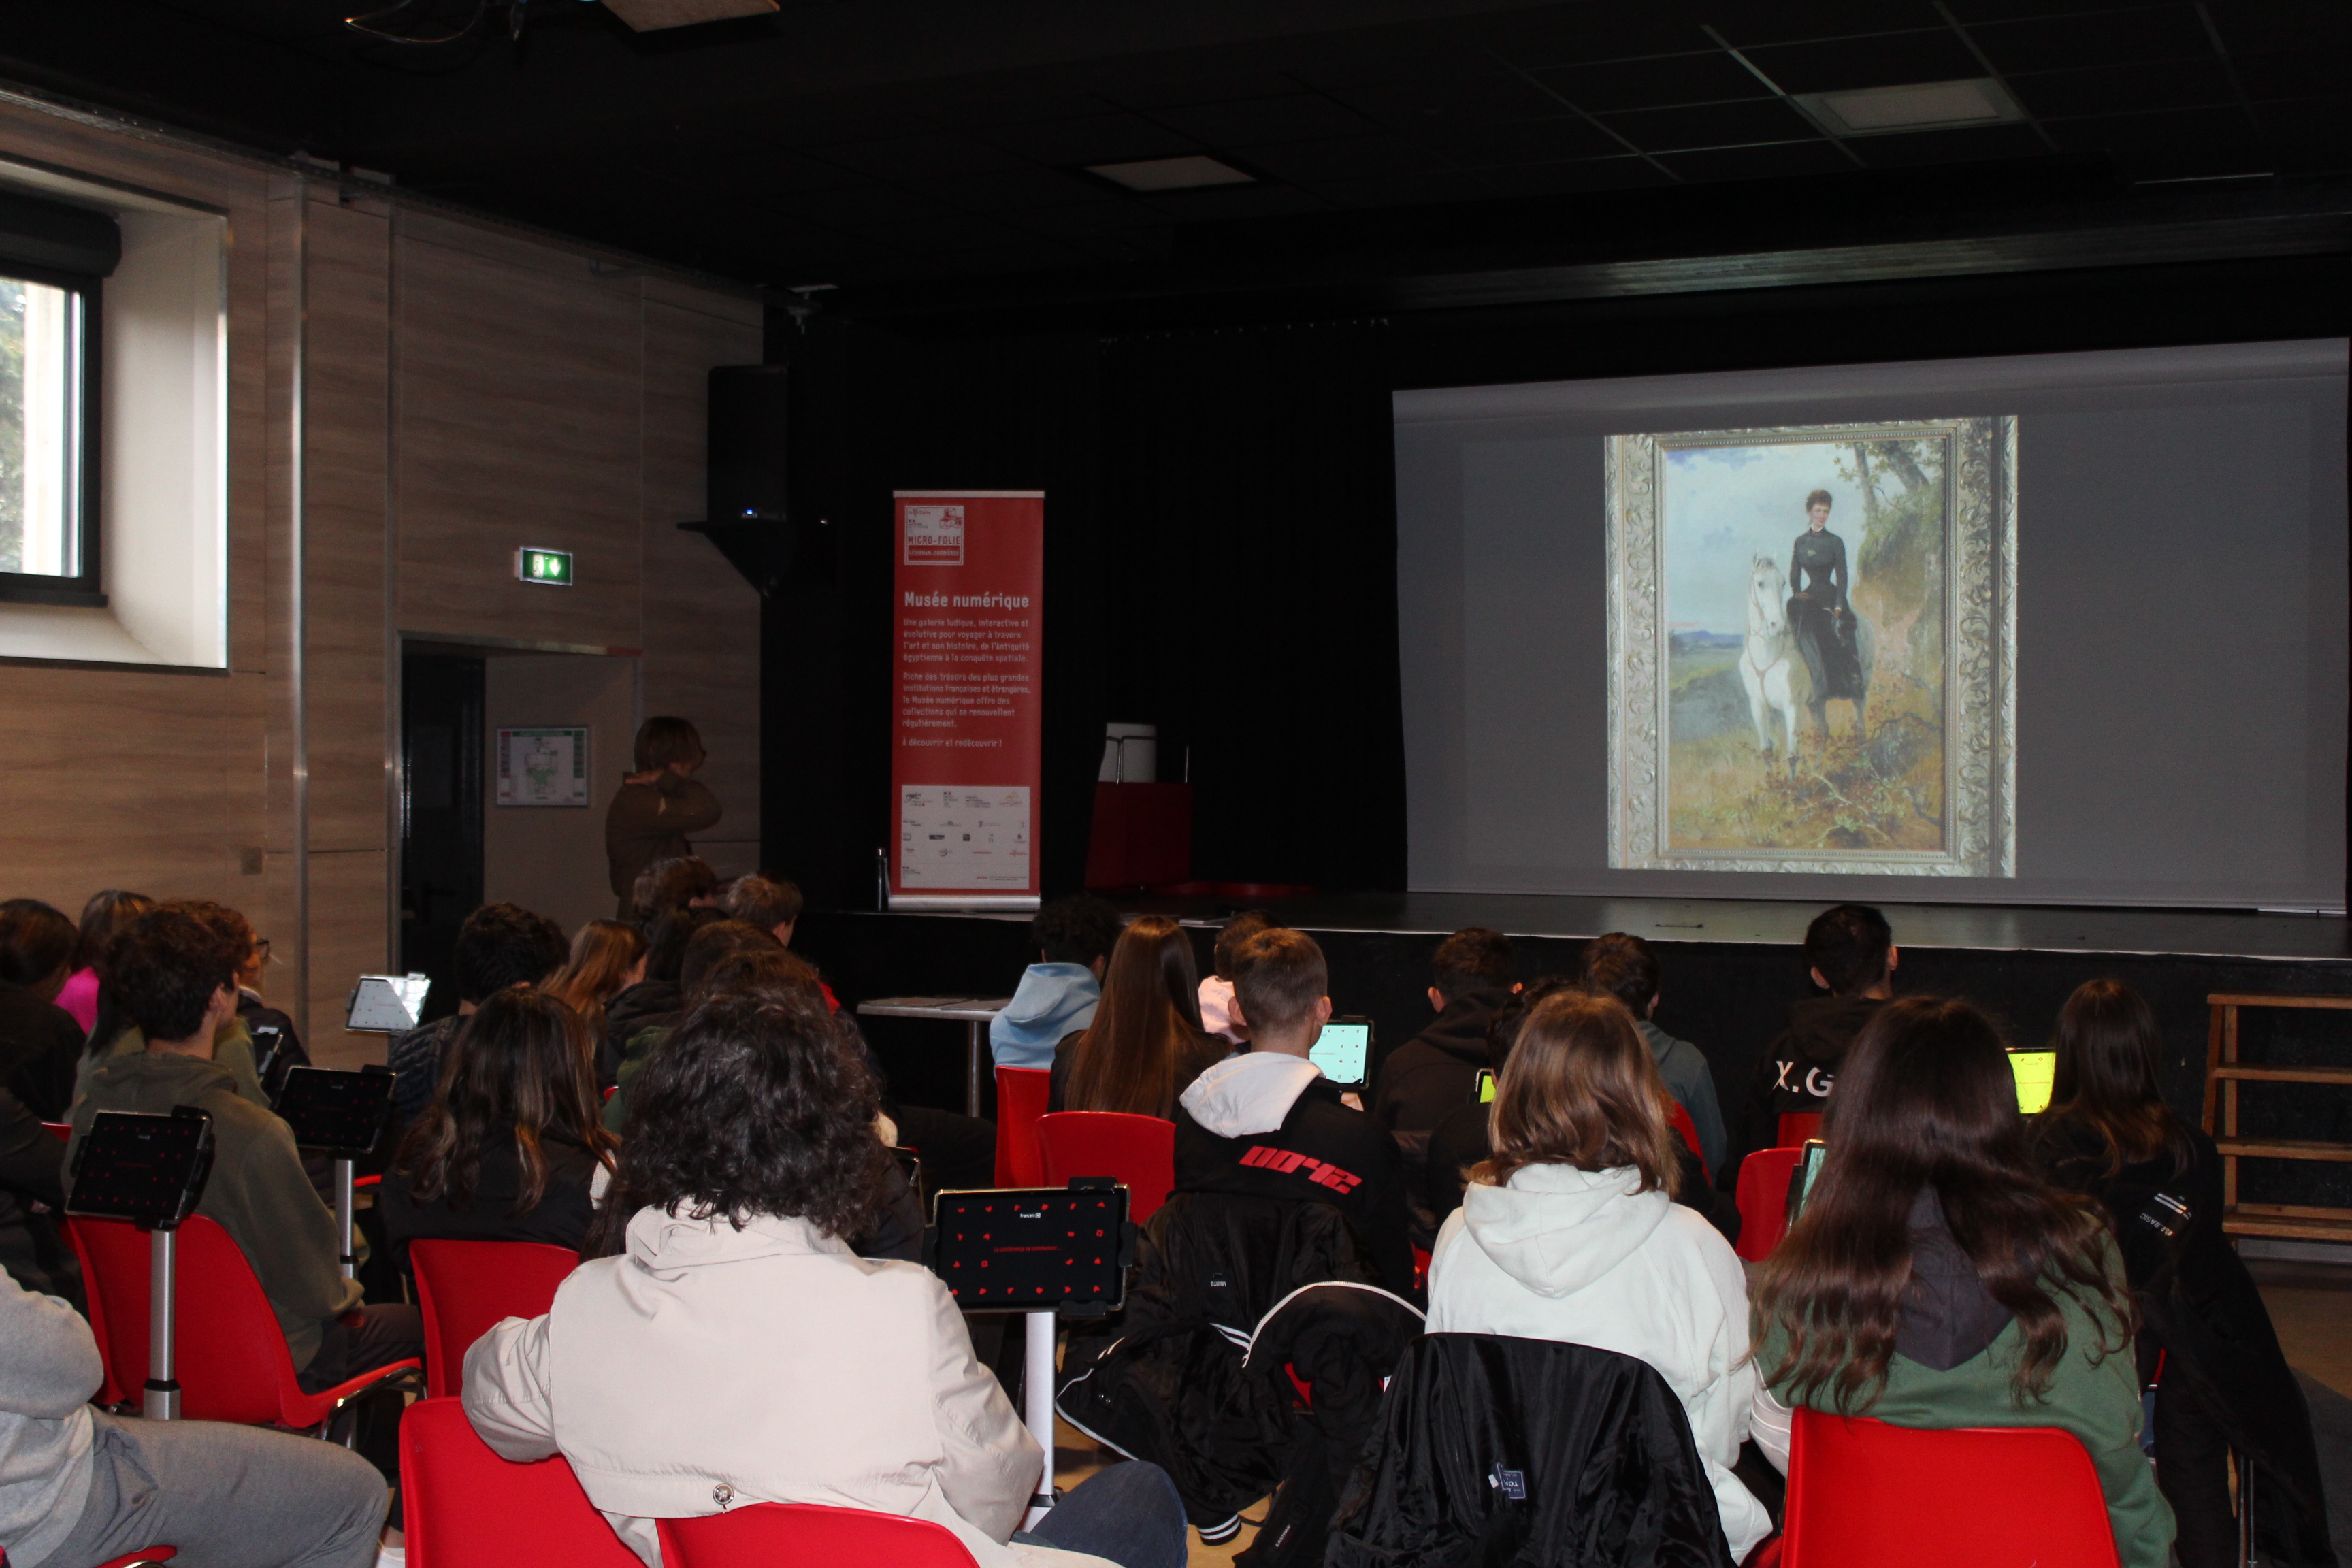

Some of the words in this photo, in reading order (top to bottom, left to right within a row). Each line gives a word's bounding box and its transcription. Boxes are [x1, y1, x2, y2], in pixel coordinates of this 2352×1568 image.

[908, 536, 961, 544] MICRO-FOLIE
[904, 591, 948, 607] Musée
[953, 591, 1029, 611] numérique
[904, 619, 917, 627] Une
[919, 619, 945, 627] galerie
[904, 630, 937, 638] évolutive
[988, 631, 992, 639] à
[981, 642, 990, 651] de
[904, 653, 943, 663] égyptienne
[960, 654, 993, 663] conquête
[904, 672, 923, 681] Riche
[940, 673, 966, 681] trésors
[983, 673, 998, 682] plus
[1001, 674, 1029, 683] grandes
[904, 685, 943, 693] institutions
[945, 685, 981, 693] françaises
[912, 696, 934, 704] Musée
[936, 696, 974, 706] numérique
[997, 697, 1010, 705] des
[946, 708, 957, 717] qui
[969, 708, 1015, 717] renouvellent
[909, 738, 943, 747] découvrir
